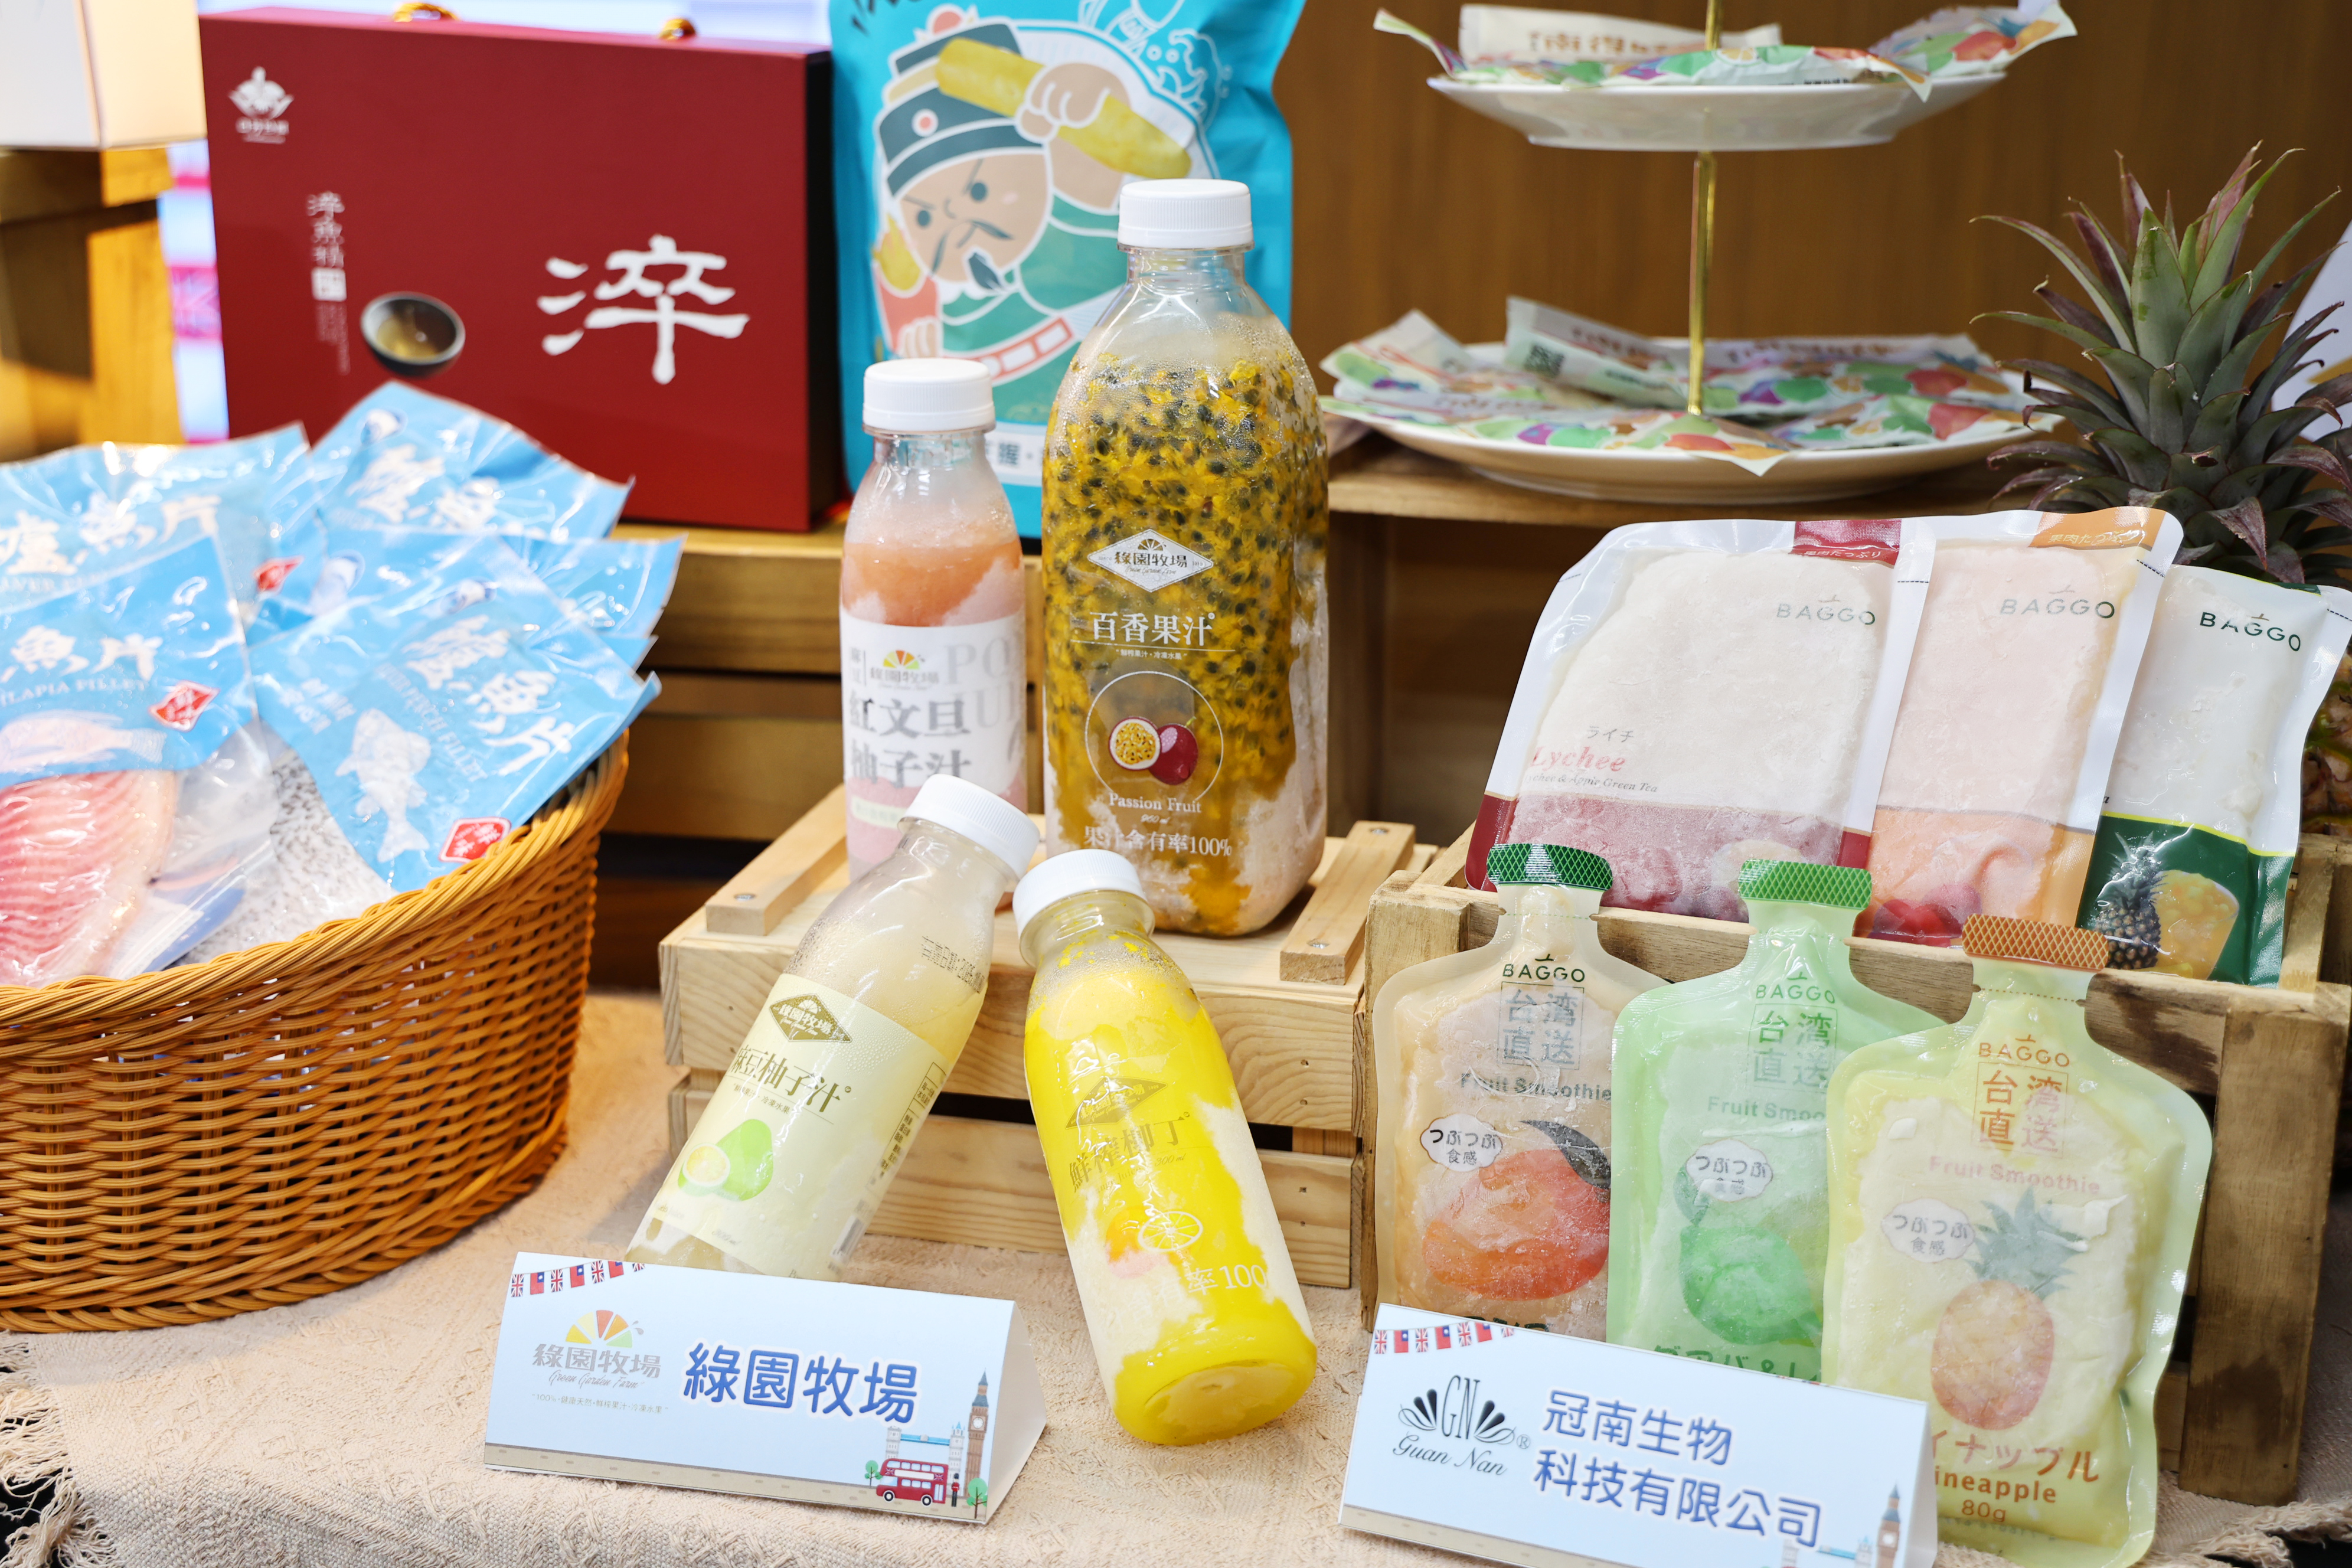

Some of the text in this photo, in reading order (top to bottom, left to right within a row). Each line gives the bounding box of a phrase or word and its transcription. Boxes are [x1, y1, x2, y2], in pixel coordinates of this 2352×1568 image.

[536, 233, 749, 384] 淬
[1115, 551, 1188, 568] 綠園牧場
[1776, 603, 1876, 626] BAGGO
[1999, 597, 2115, 619] BAGGO
[1089, 612, 1212, 646] 百香果汁
[2199, 611, 2301, 652] BAGGO
[1587, 726, 1634, 743] ライチ
[1530, 746, 1626, 772] Lychee
[1603, 778, 1636, 790] Green
[1639, 782, 1658, 792] Tea
[1109, 793, 1202, 813] Passion Fruit
[1502, 963, 1586, 983] BAGGO
[1755, 984, 1836, 1004] BAGGO
[1505, 989, 1579, 1027] 台湾
[1758, 1010, 1832, 1049] 台湾
[1502, 1028, 1575, 1065] 直送
[1978, 1042, 2070, 1067] BAGGO
[1982, 1069, 2063, 1116] 台湾
[1707, 1096, 1758, 1117] Fruit
[1429, 1129, 1497, 1149] つぶつぶ
[1979, 1109, 2059, 1156] 直送
[1154, 1154, 1176, 1168] 300
[1447, 1149, 1477, 1165] 食感
[1695, 1155, 1768, 1179] つぶつぶ
[1929, 1155, 2101, 1195] Fruit Smoothie
[1892, 1213, 1969, 1242] つぶつぶ
[1910, 1238, 1945, 1257] 食感
[532, 1343, 662, 1379] 綠園牧場
[548, 1368, 577, 1387] Green
[578, 1374, 612, 1390] Garden
[684, 1342, 918, 1424] 綠園牧場
[1440, 1374, 1481, 1440] GN
[1542, 1389, 1733, 1466] 冠南生物
[1392, 1432, 1507, 1476] Guan Nan
[1534, 1449, 1821, 1547] 科技有限公司
[1961, 1500, 2007, 1523] 80g
